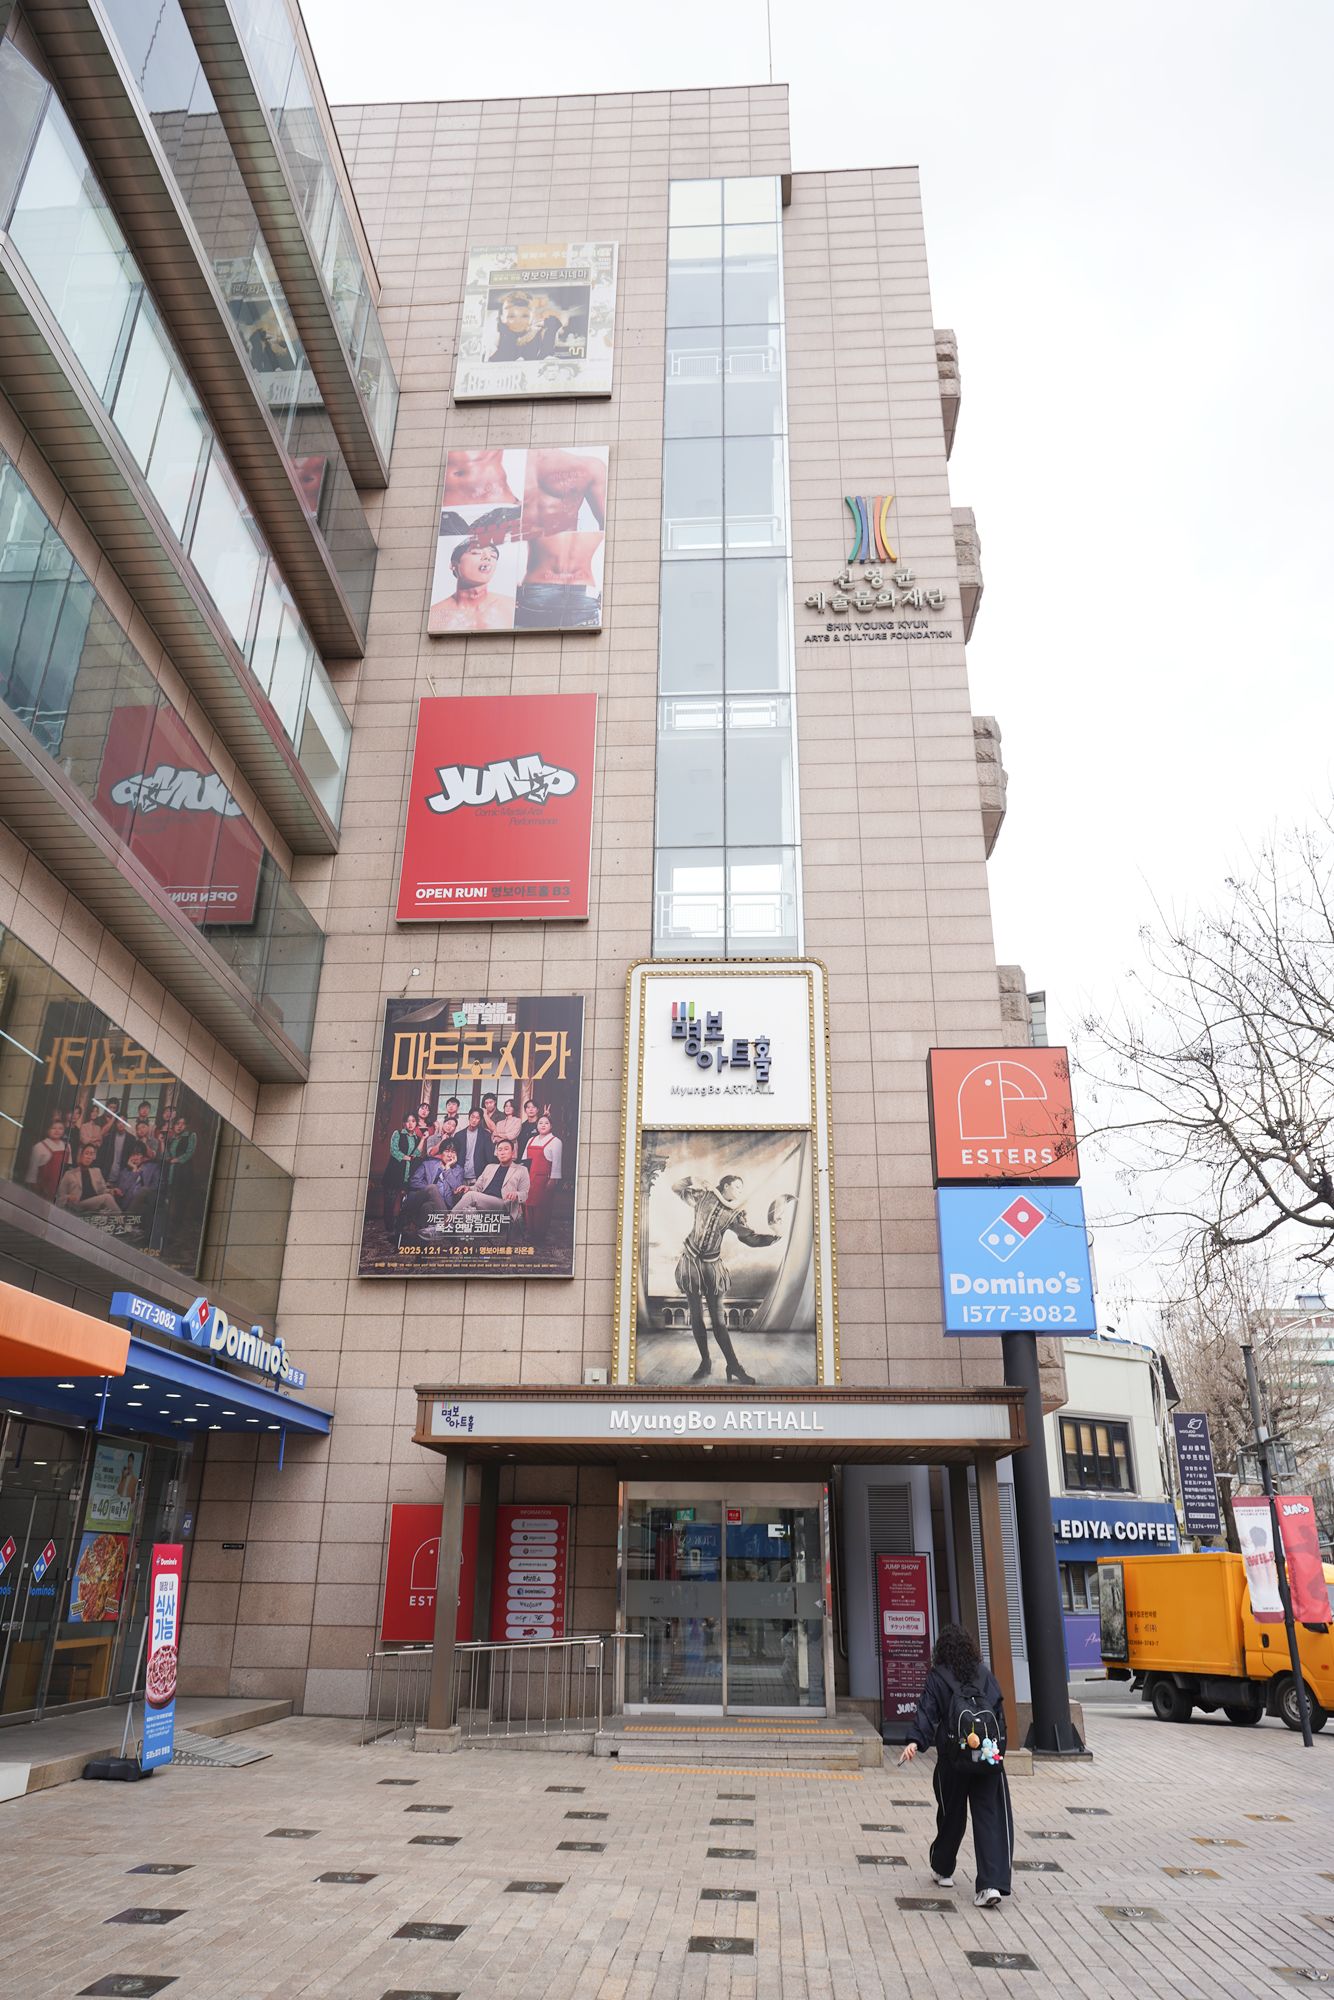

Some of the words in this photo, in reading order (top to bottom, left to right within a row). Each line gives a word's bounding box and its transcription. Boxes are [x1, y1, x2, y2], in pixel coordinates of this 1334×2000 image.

[521, 270, 588, 282] 명보아트시네마
[804, 587, 946, 614] 예술문화재단
[826, 622, 852, 632] SHIN
[856, 621, 894, 631] YOUNG
[898, 620, 929, 630] KYUN
[804, 634, 830, 643] ARTS
[833, 634, 840, 643] &
[844, 632, 887, 642] CULTURE
[891, 630, 952, 640] FOUNDATION
[426, 752, 577, 813] JUMP
[416, 888, 452, 899] OPEN
[455, 887, 488, 898] RUN!
[491, 886, 549, 897] 명보아트홀
[696, 1035, 772, 1083] 아트홀
[671, 1085, 721, 1097] MyungBo
[724, 1085, 775, 1096] ARTHALL
[961, 1148, 1054, 1165] ESTERS
[484, 1213, 511, 1223] 터지는
[474, 1223, 500, 1233] 코미디
[479, 1247, 512, 1255] 명보아트홀
[950, 1271, 1082, 1295] Domino's
[962, 1305, 1077, 1323] 1577-3082
[131, 1298, 176, 1331] 1577-3082
[210, 1306, 290, 1379] Domino's
[609, 1410, 717, 1434] MyungBo
[723, 1410, 824, 1430] ARTHALL
[1060, 1519, 1112, 1539] EDIYA
[1114, 1521, 1177, 1541] COFFEE
[156, 1594, 175, 1616] 식사
[155, 1618, 174, 1640] 가능
